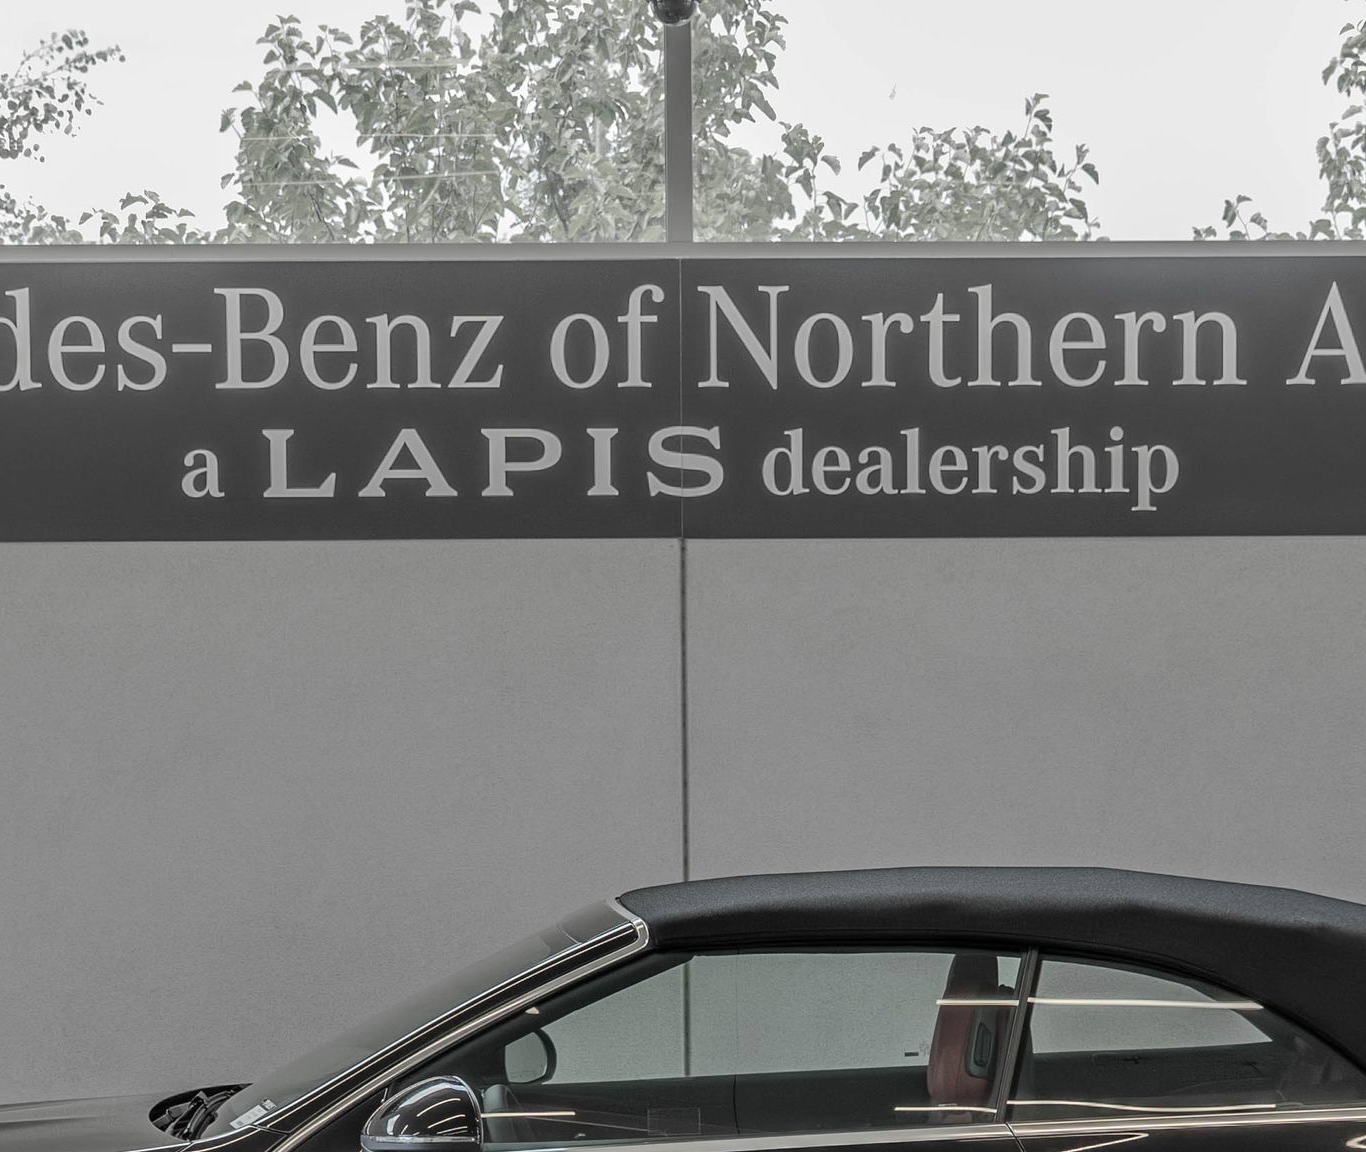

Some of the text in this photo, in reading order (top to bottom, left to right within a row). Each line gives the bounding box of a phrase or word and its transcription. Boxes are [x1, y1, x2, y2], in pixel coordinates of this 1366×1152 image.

[549, 283, 666, 389] of
[696, 283, 1249, 390] Northern
[181, 425, 1180, 512] a LAPIS dealership
